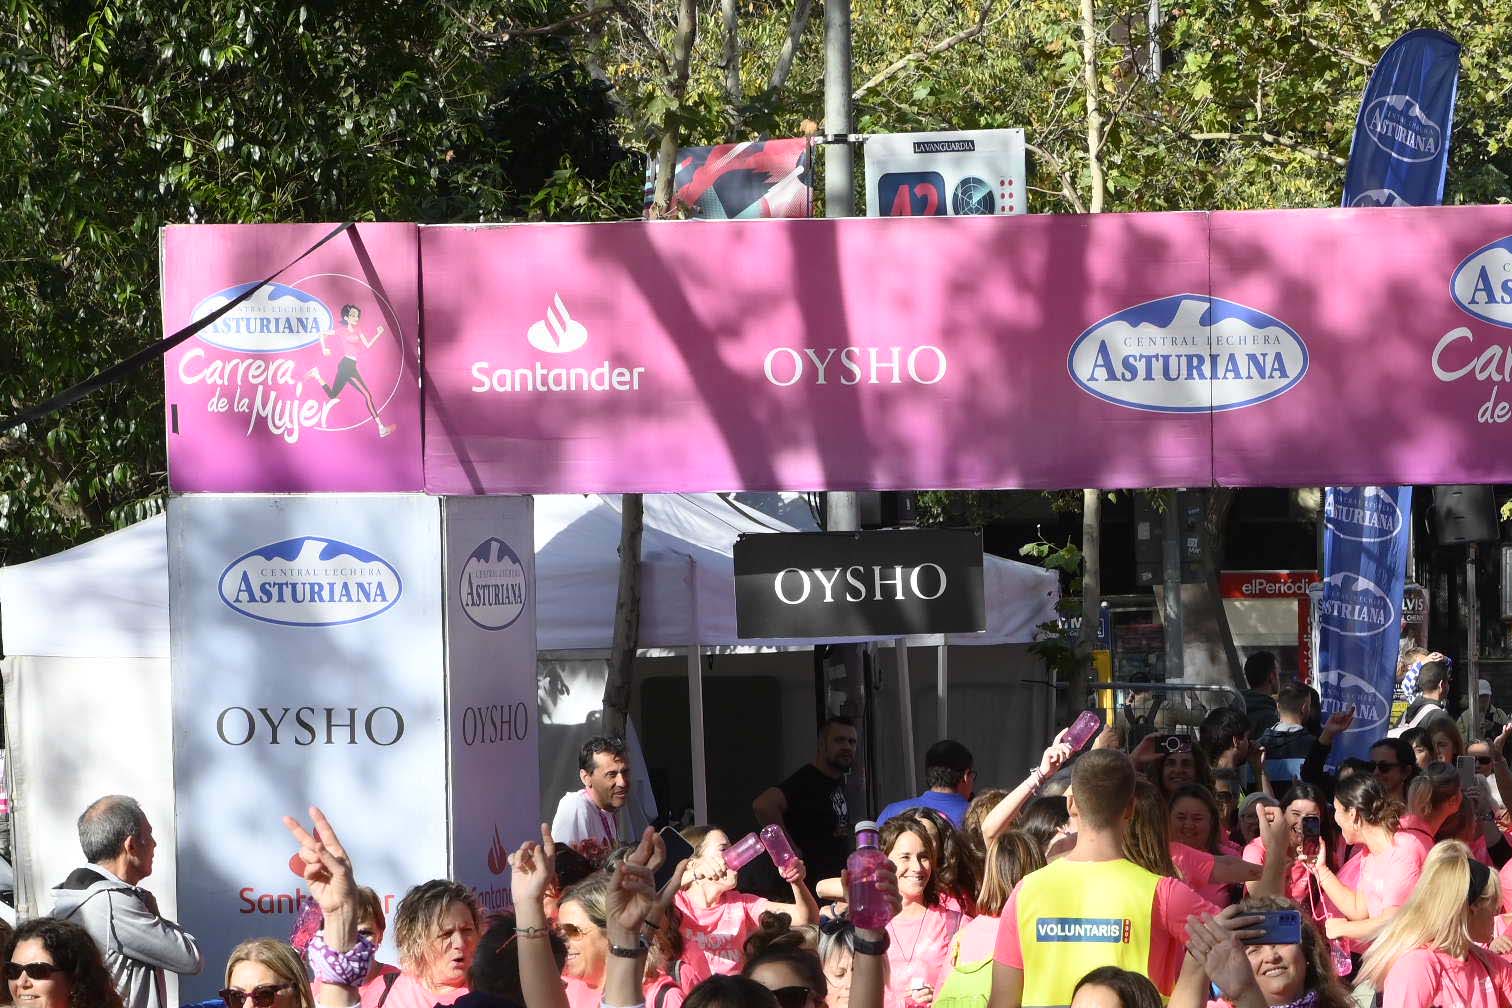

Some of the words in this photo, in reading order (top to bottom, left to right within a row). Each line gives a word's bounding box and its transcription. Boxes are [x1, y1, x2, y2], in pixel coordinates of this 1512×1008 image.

[205, 315, 322, 334] ASTURIANA
[1124, 336, 1197, 347] CENTRAL
[1206, 335, 1281, 346] LECHERA
[178, 347, 295, 385] Carrera
[472, 360, 645, 392] Santander
[763, 344, 947, 387] OYSHO
[1087, 339, 1290, 382] ASTURIANA
[207, 385, 229, 413] de
[234, 385, 250, 413] la
[247, 381, 341, 444] Mujer
[1477, 385, 1512, 423] de
[233, 570, 388, 603] ASTURIANA
[260, 567, 321, 577] CENTRAL
[325, 567, 384, 577] LECHERA
[465, 571, 522, 607] ASTURIANA
[774, 562, 948, 605] OYSHO
[216, 706, 405, 746] OYSHO
[462, 702, 529, 746] OYSHO
[1038, 924, 1120, 937] VOLUNTARIS
